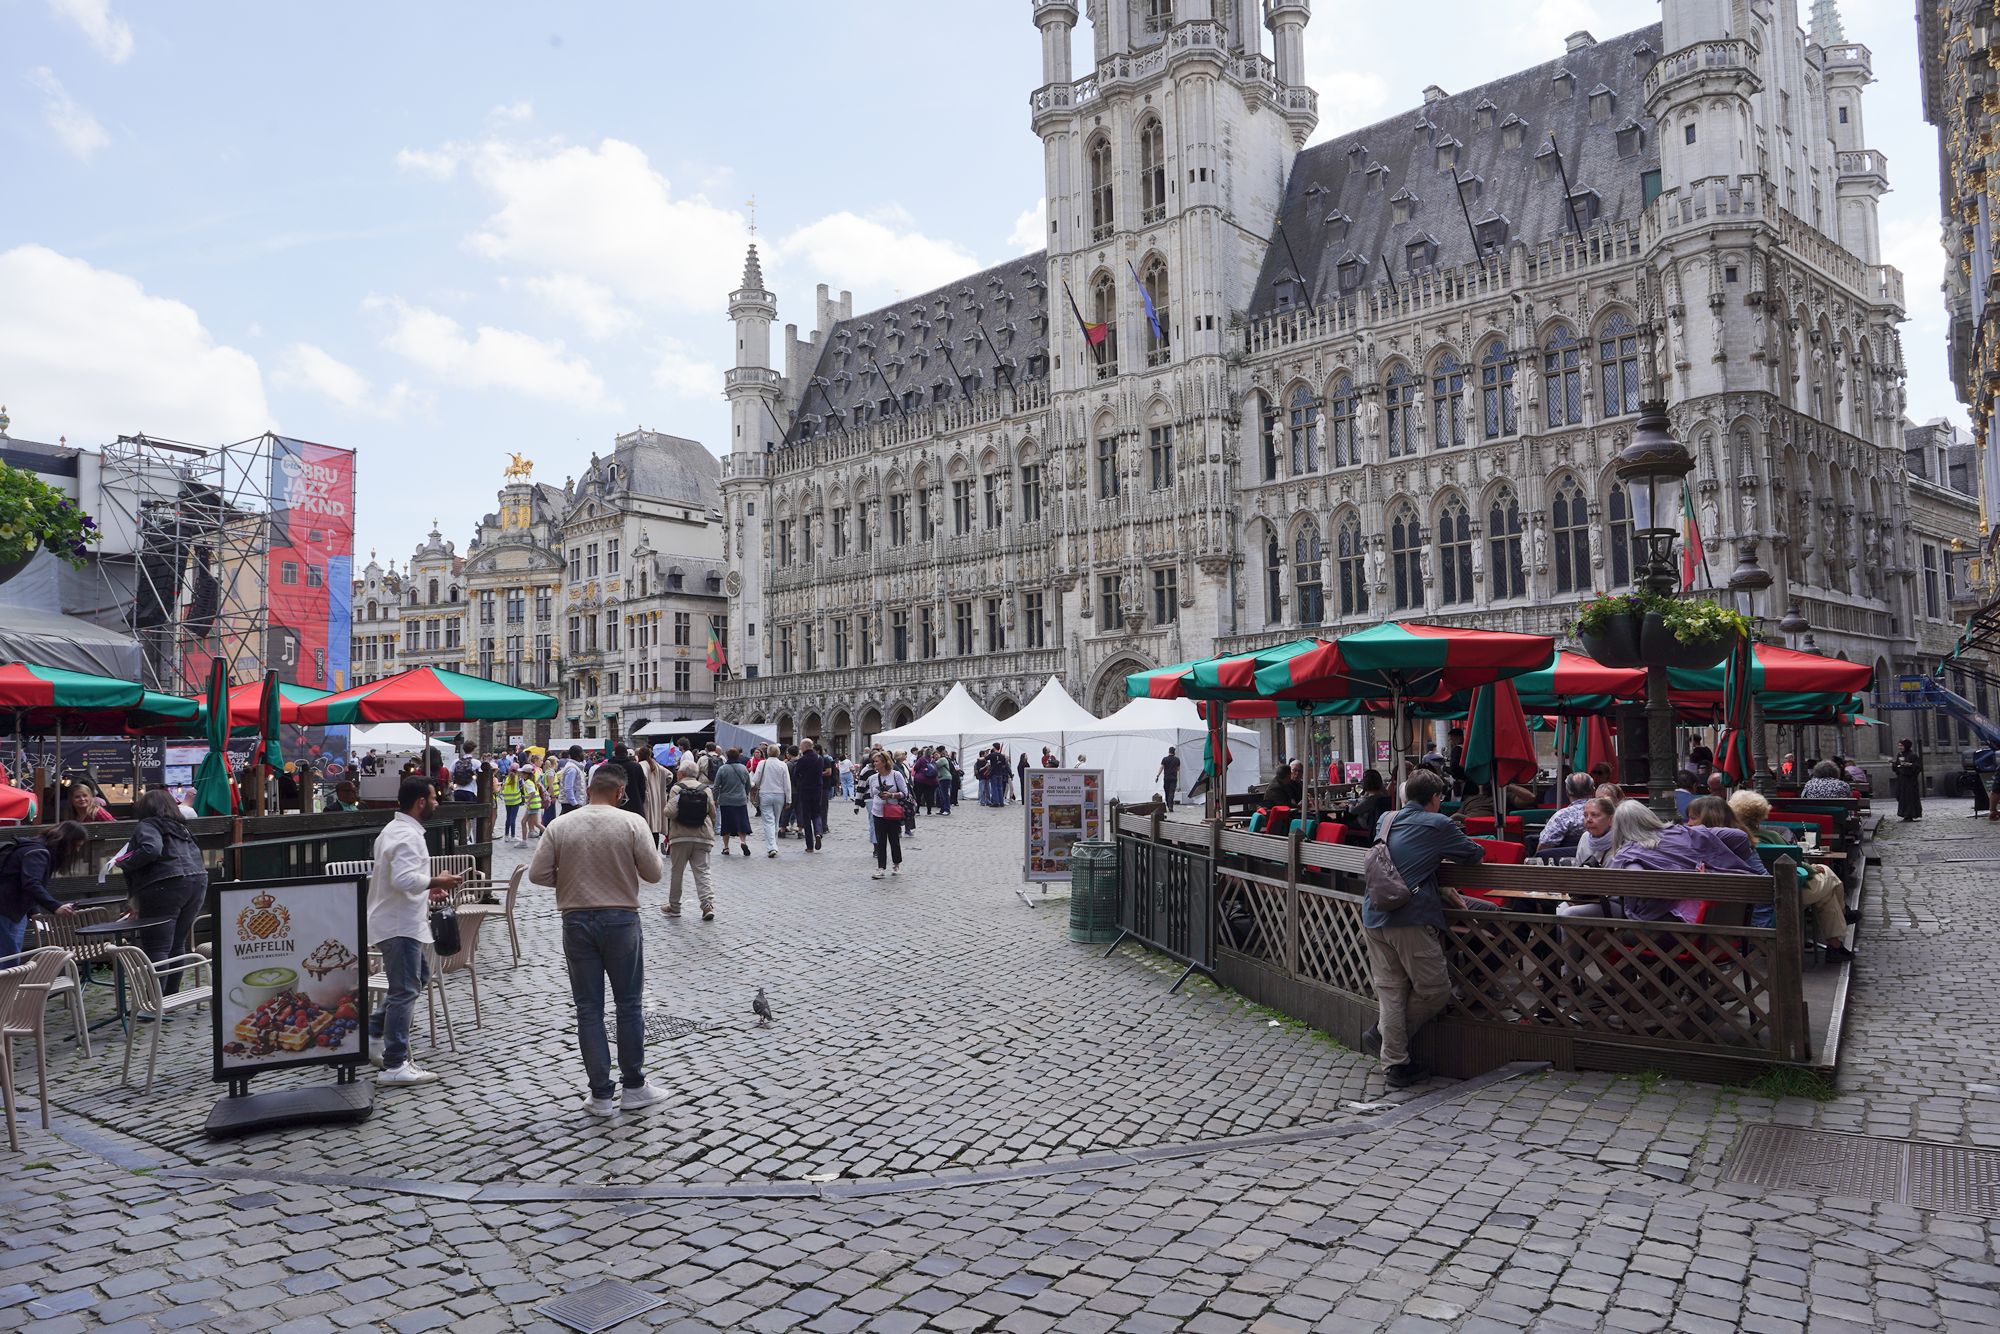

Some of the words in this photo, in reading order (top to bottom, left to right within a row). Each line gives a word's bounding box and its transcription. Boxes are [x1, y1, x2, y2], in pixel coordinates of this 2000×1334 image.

[303, 463, 338, 484] BRU
[283, 477, 329, 499] JAZZ
[283, 493, 345, 517] WKND
[234, 940, 295, 957] WAFFELIN
